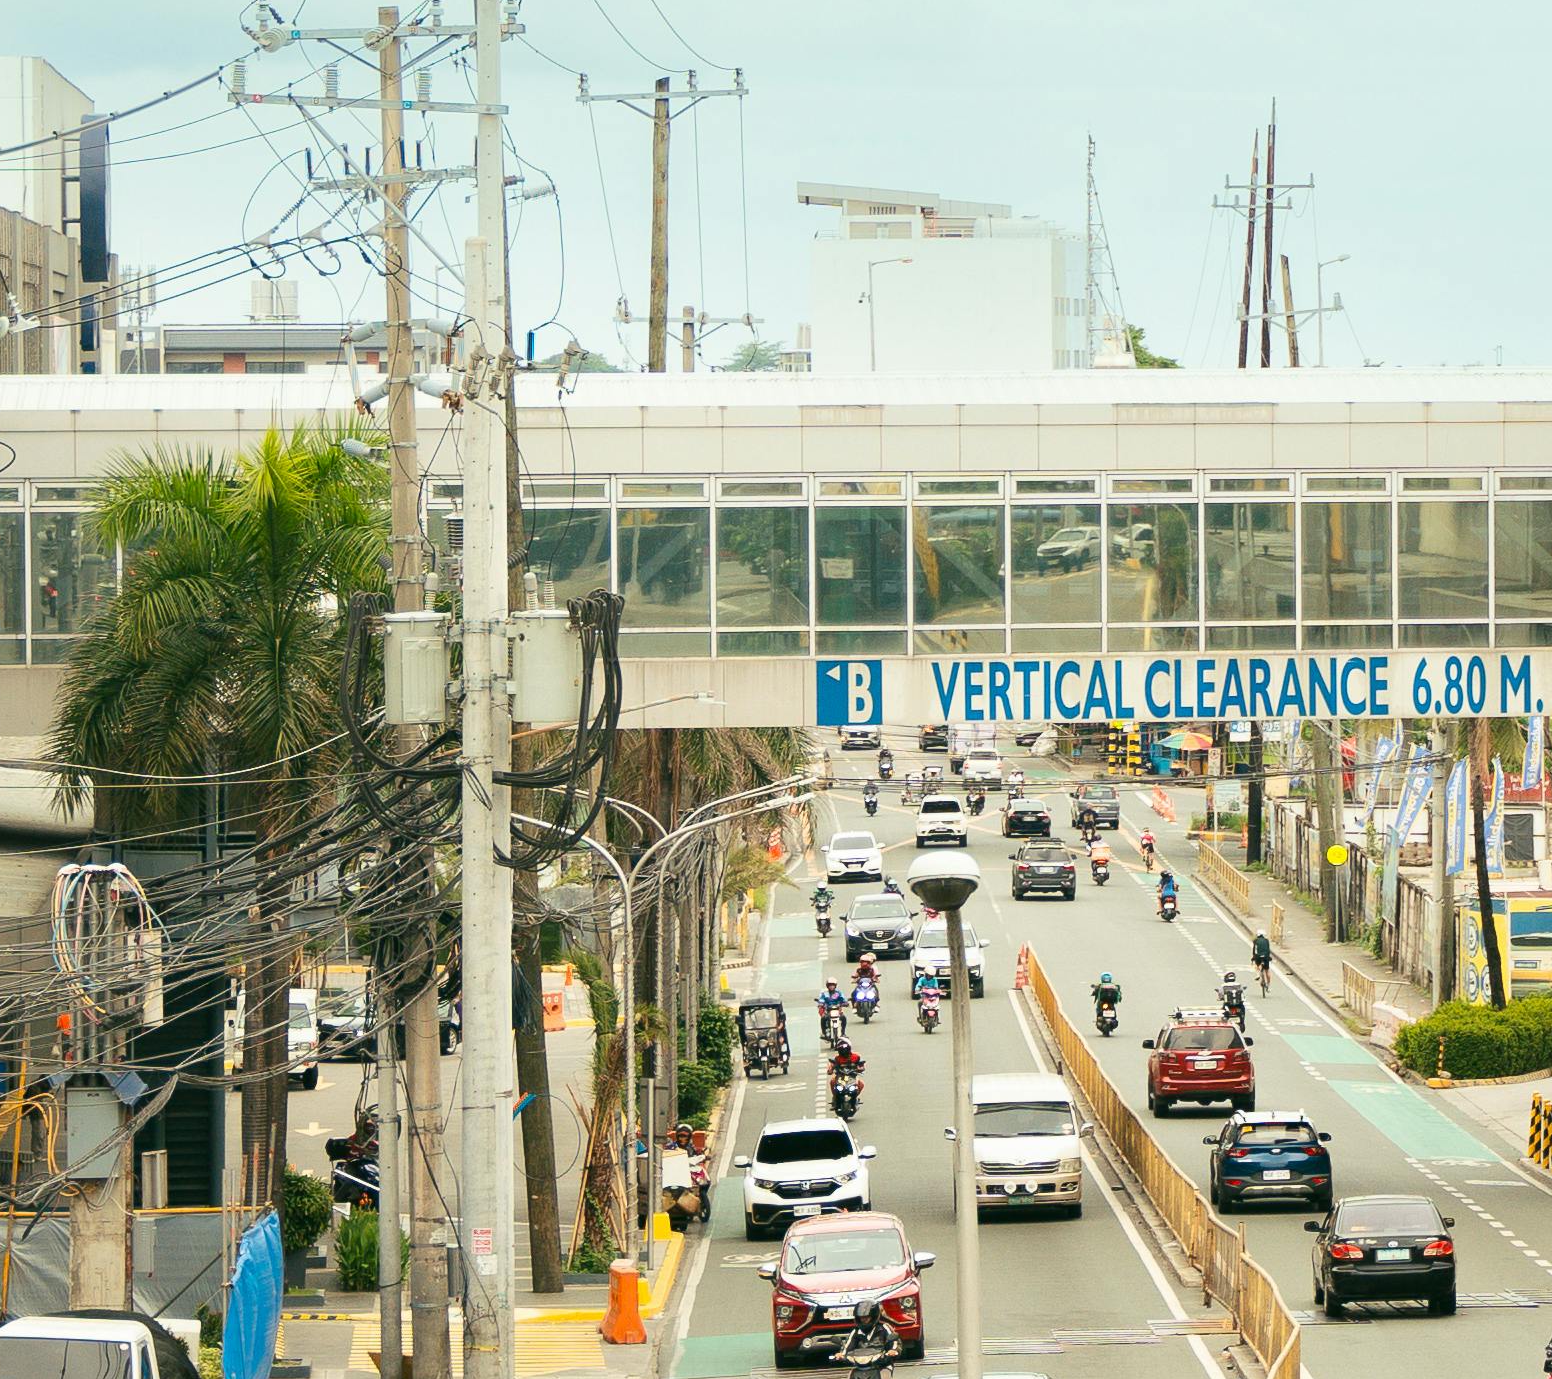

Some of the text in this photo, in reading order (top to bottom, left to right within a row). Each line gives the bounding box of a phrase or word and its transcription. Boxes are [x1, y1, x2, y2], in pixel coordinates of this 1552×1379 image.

[850, 662, 874, 724] B
[932, 654, 1544, 721] VERTICAL CLEARANCE 6.80 M.
